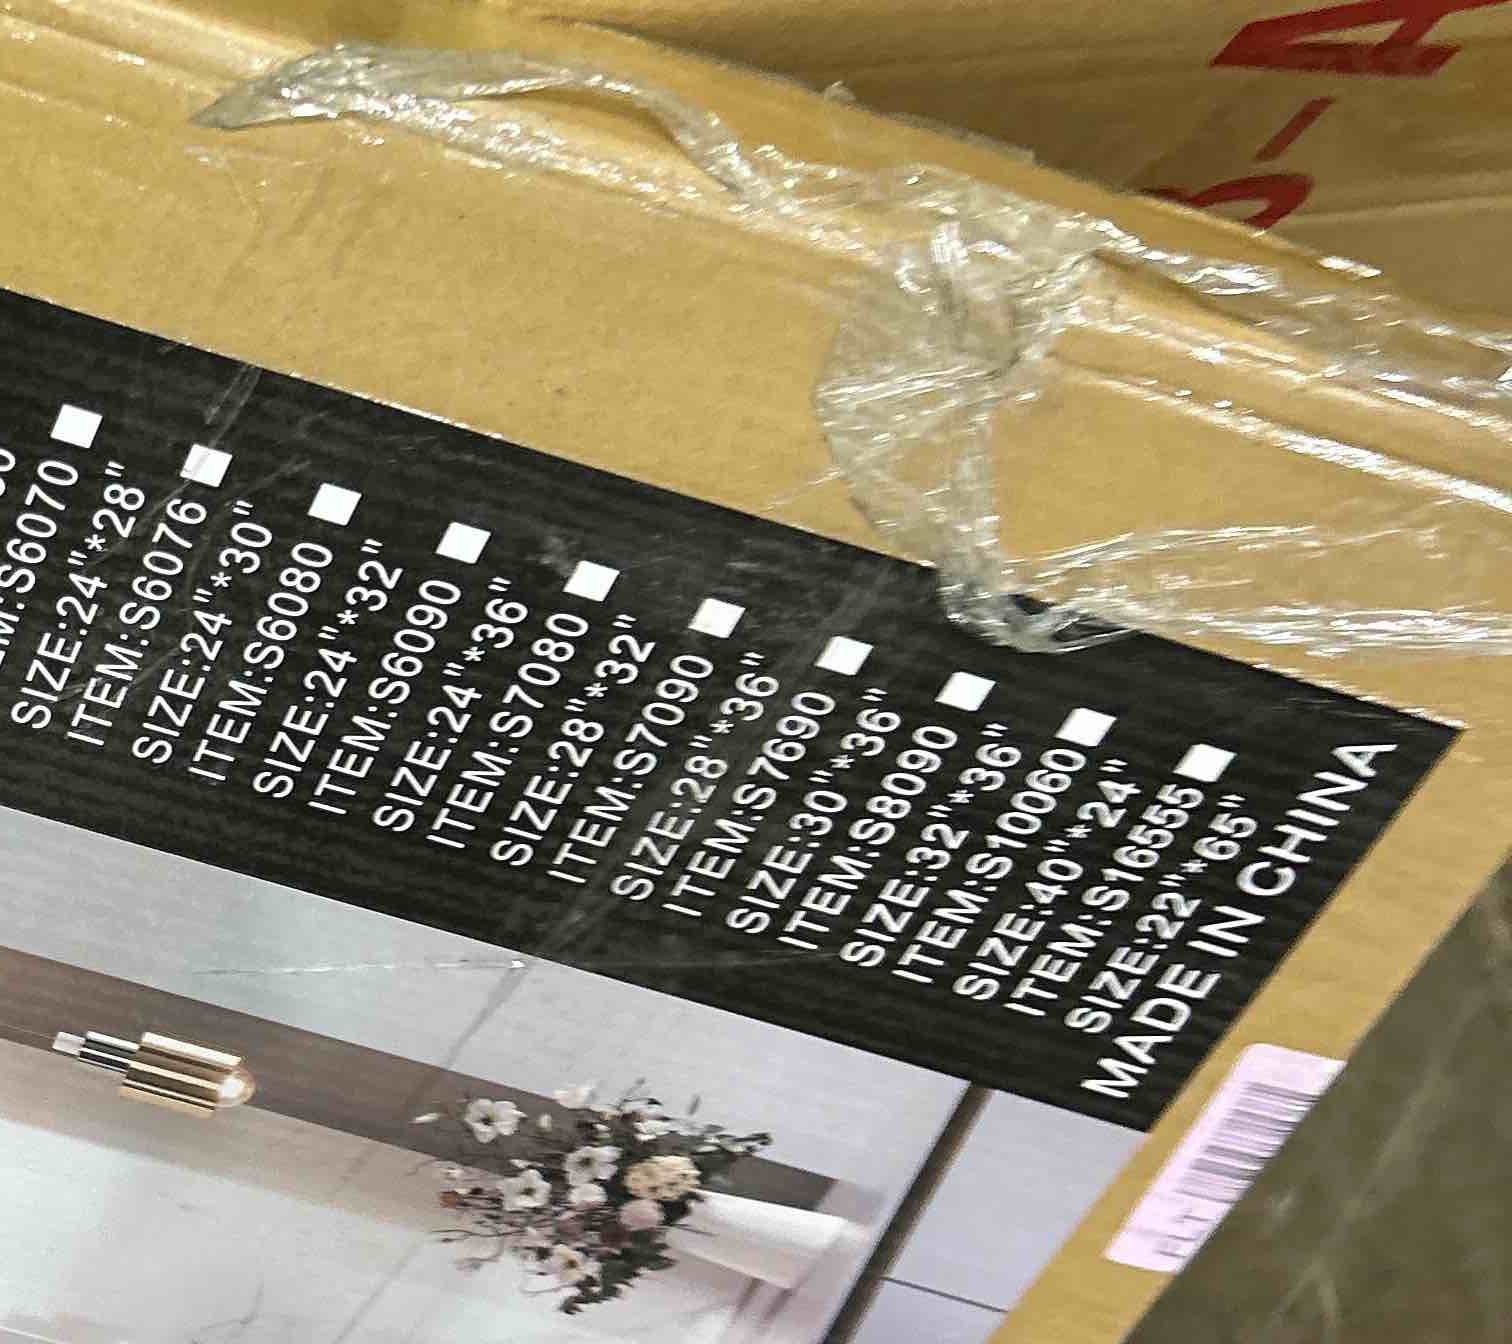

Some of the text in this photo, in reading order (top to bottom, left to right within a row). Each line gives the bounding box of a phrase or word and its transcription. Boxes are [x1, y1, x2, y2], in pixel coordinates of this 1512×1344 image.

[66, 498, 207, 745] ITEM:S6076
[187, 542, 332, 780] ITEM:S6080
[308, 579, 461, 814] ITEM:S6090
[426, 613, 588, 848] ITEM:S7080
[547, 654, 713, 883] ITEM:S7090
[662, 691, 835, 916] ITEM:S7690
[777, 725, 957, 949] ITEM:S8090
[891, 748, 1086, 983] ITEM:S10060
[1003, 783, 1203, 1016] ITEM:S16555
[1080, 743, 1397, 1097] MADE IN CHINA
